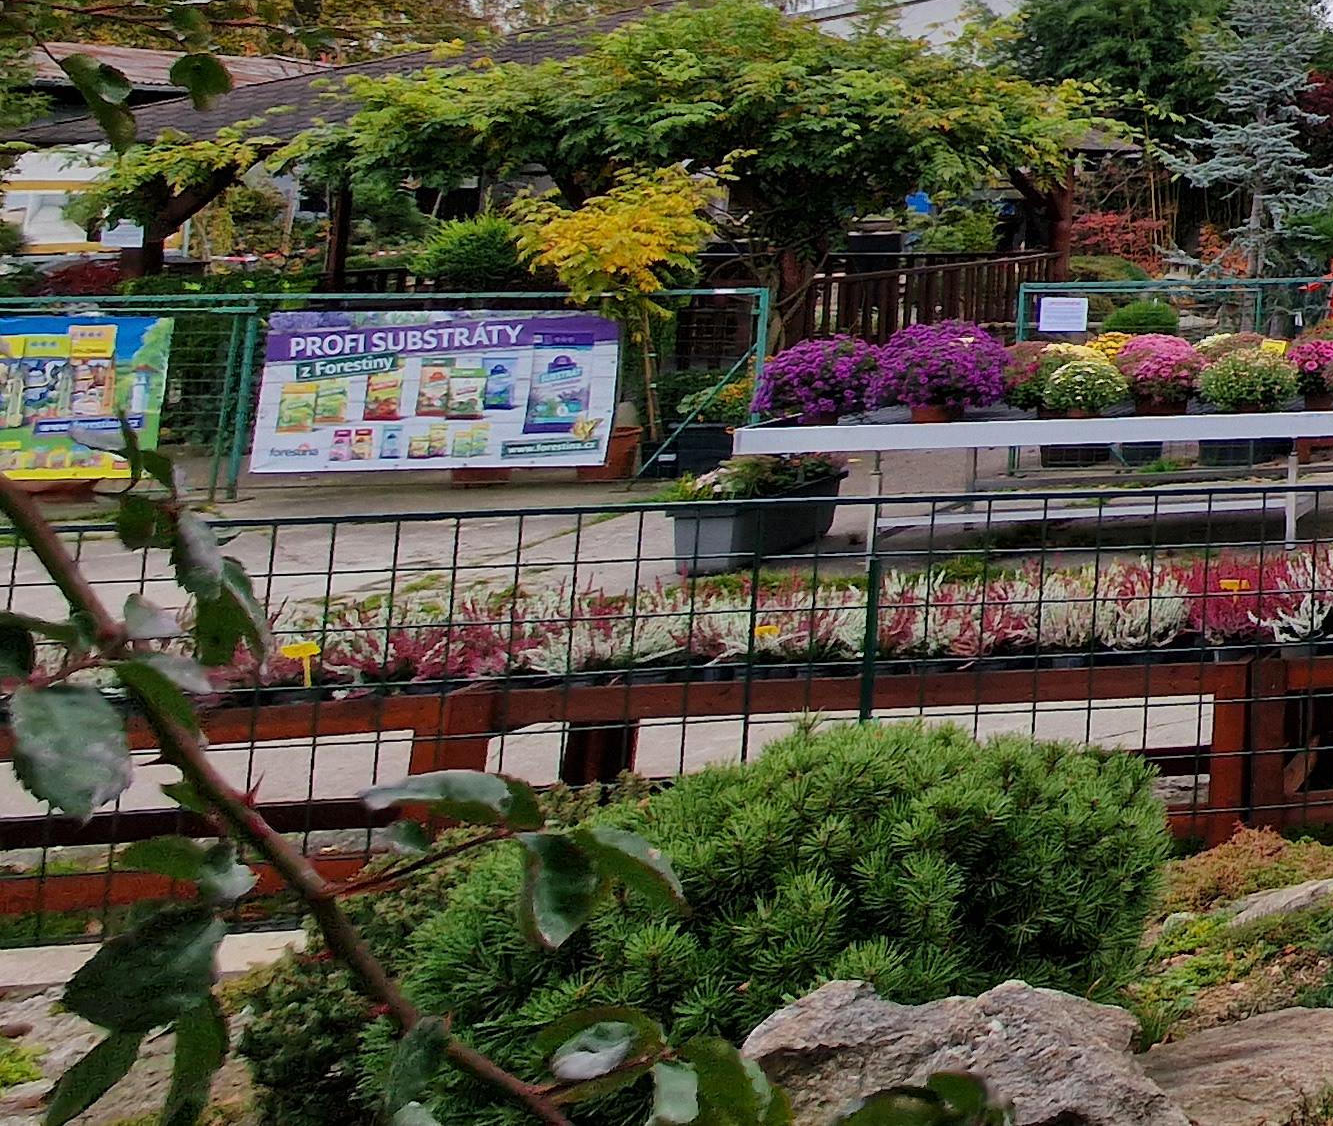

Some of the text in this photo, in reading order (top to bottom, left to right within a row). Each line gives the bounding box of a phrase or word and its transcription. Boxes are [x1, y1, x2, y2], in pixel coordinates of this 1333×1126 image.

[289, 322, 524, 358] PROFI SUBSTRÁTY
[300, 355, 395, 378] z Forestiny
[507, 440, 596, 454] www.forestina.cz
